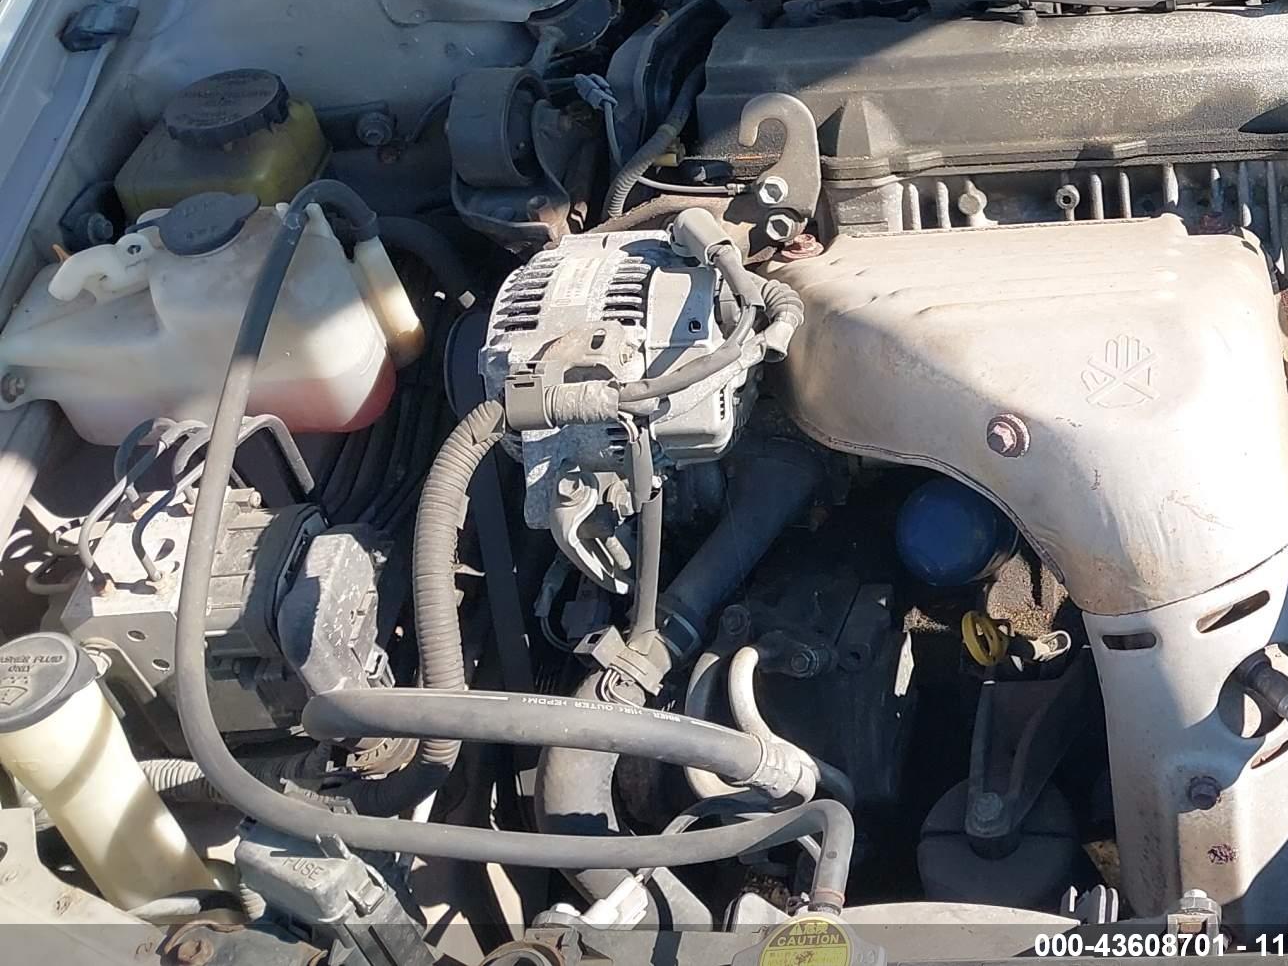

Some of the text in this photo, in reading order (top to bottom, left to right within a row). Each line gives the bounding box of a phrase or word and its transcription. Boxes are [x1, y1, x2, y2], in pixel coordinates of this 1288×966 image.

[574, 701, 613, 711] OUTER
[282, 857, 325, 881] FUSE
[777, 933, 840, 946] CAUTION
